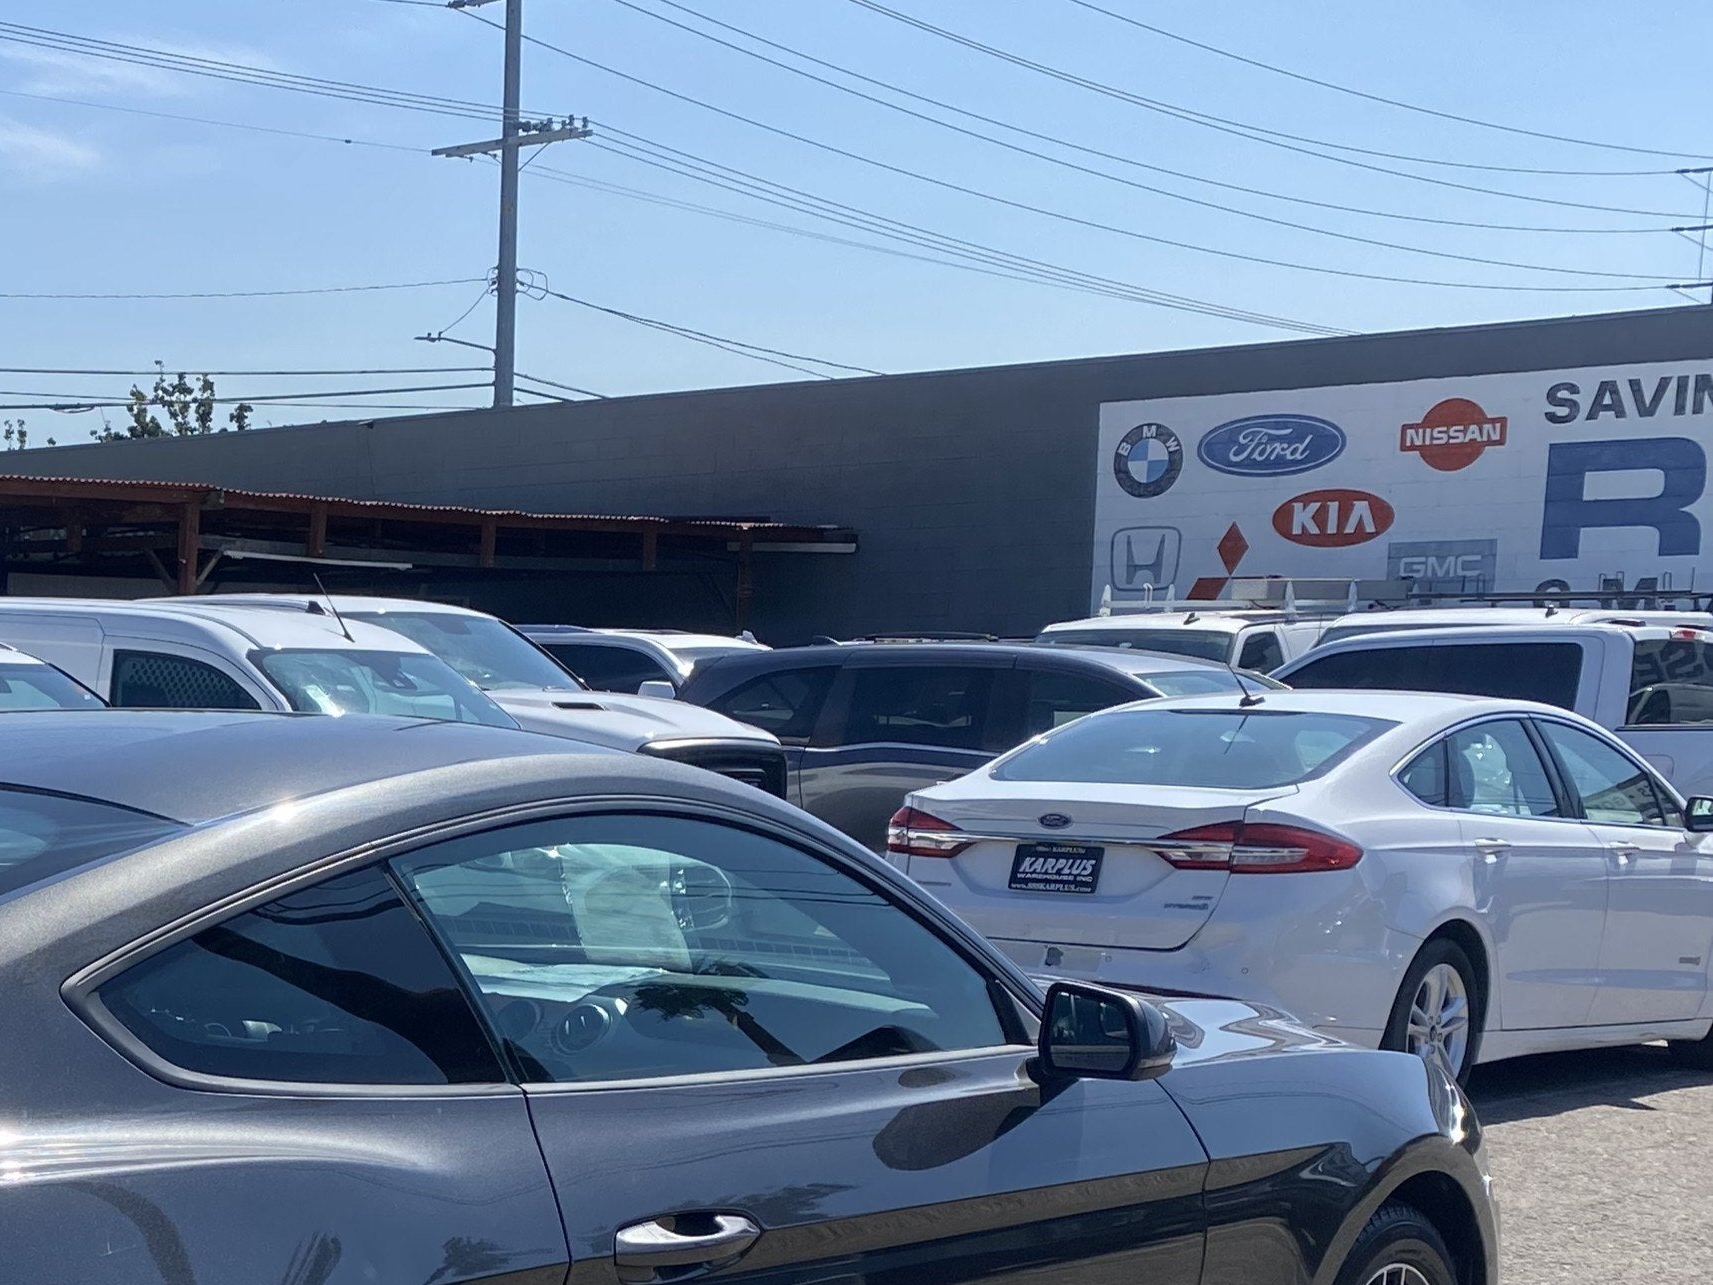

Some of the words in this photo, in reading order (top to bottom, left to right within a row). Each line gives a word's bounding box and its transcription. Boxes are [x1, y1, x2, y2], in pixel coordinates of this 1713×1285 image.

[1117, 424, 1181, 458] BMW
[1228, 427, 1314, 462] Ford
[1405, 422, 1502, 447] NISSAN
[1291, 500, 1377, 536] KIA
[1399, 554, 1483, 579] GMC
[1018, 856, 1097, 876] KARPLUS
